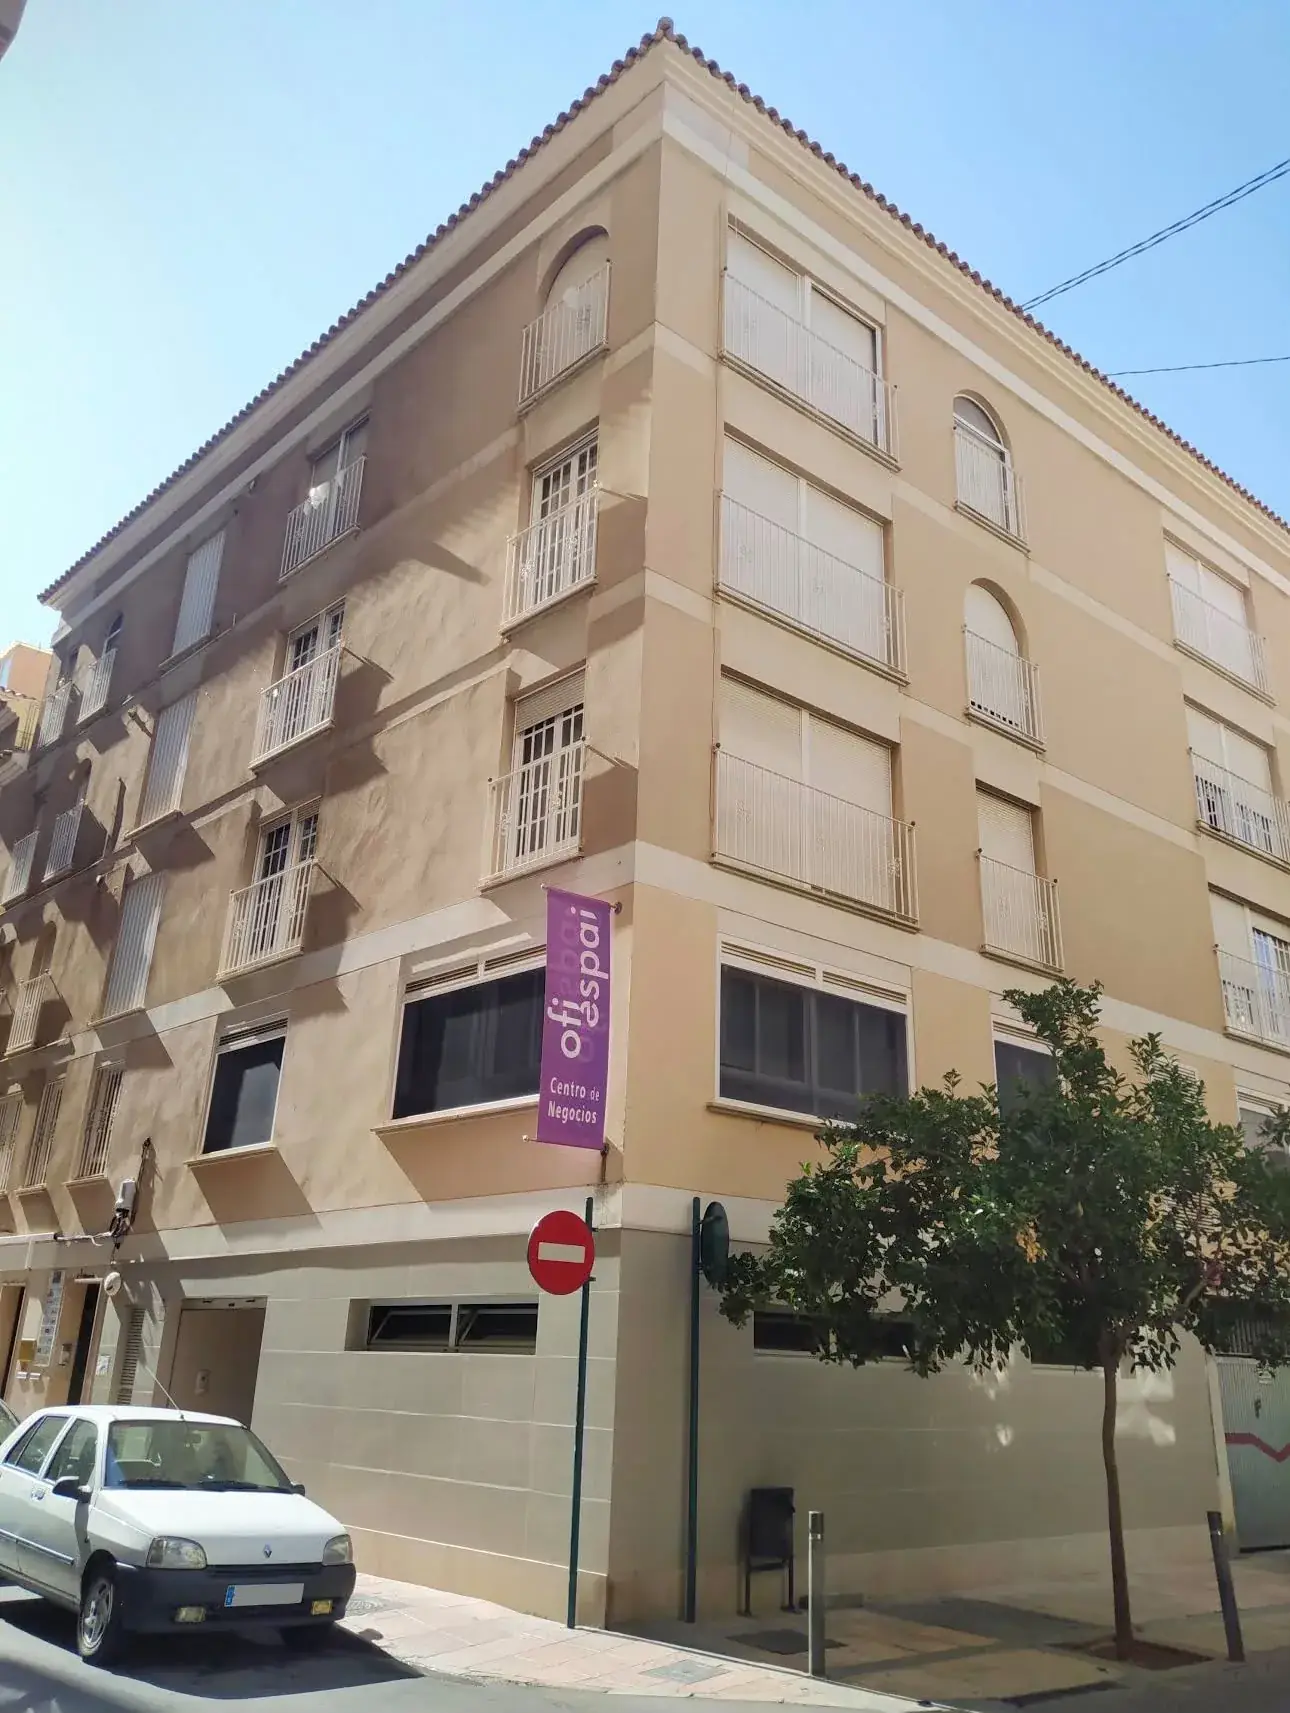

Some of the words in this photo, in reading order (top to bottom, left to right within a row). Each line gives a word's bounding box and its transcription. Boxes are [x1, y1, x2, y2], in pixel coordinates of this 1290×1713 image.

[550, 1076, 586, 1099] Centro
[590, 1086, 600, 1102] de
[547, 1100, 597, 1124] Negocios
